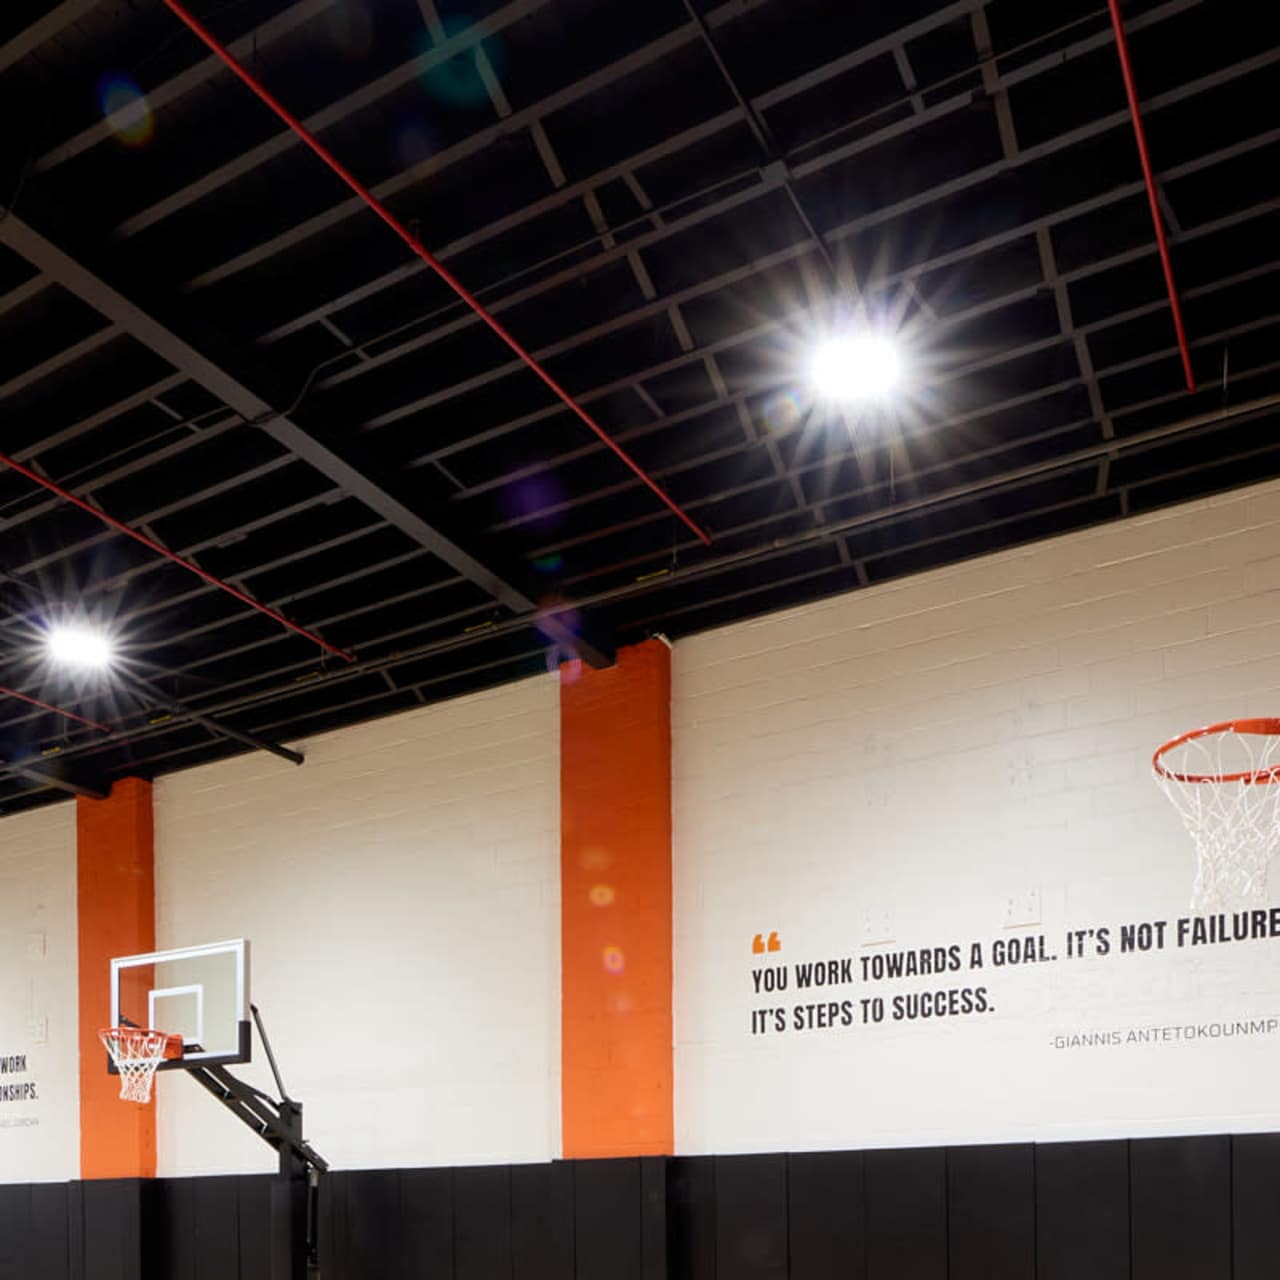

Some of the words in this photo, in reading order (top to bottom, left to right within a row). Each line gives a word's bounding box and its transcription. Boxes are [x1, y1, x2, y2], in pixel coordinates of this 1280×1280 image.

[752, 966, 788, 994] YOU
[795, 958, 853, 989] WORK
[860, 945, 961, 982] TOWARDS
[969, 942, 983, 969] A
[992, 935, 1058, 967] GOAL.
[1067, 927, 1110, 959] IT'S
[1120, 921, 1167, 953] NOT
[752, 1007, 786, 1035] IT'S
[793, 1000, 853, 1031] STEPS
[860, 997, 884, 1024] TO
[892, 986, 995, 1020] SUCCESS.
[1049, 1031, 1121, 1049] -GIANNIS
